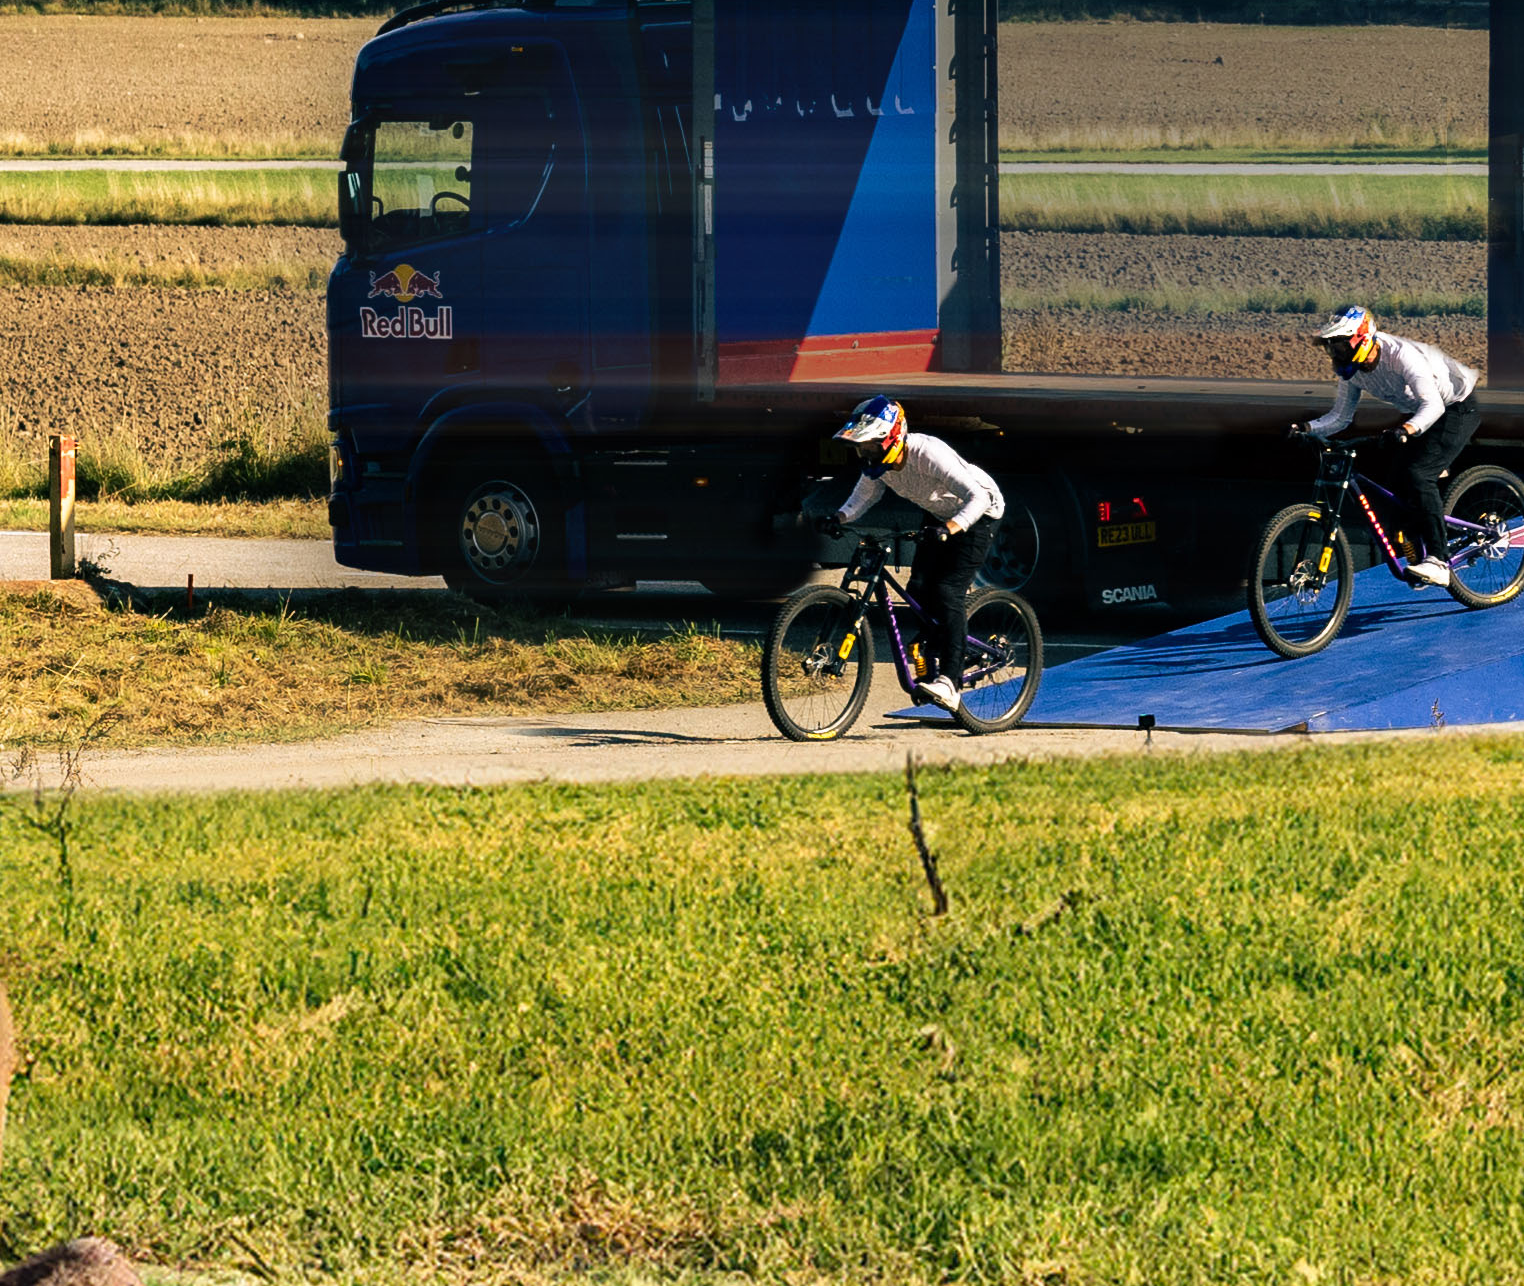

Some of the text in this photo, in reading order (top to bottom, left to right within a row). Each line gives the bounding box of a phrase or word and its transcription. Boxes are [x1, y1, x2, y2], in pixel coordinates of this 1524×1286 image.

[360, 306, 453, 339] Red Bull
[1101, 525, 1129, 545] RE23
[1102, 584, 1158, 604] SCANIA
